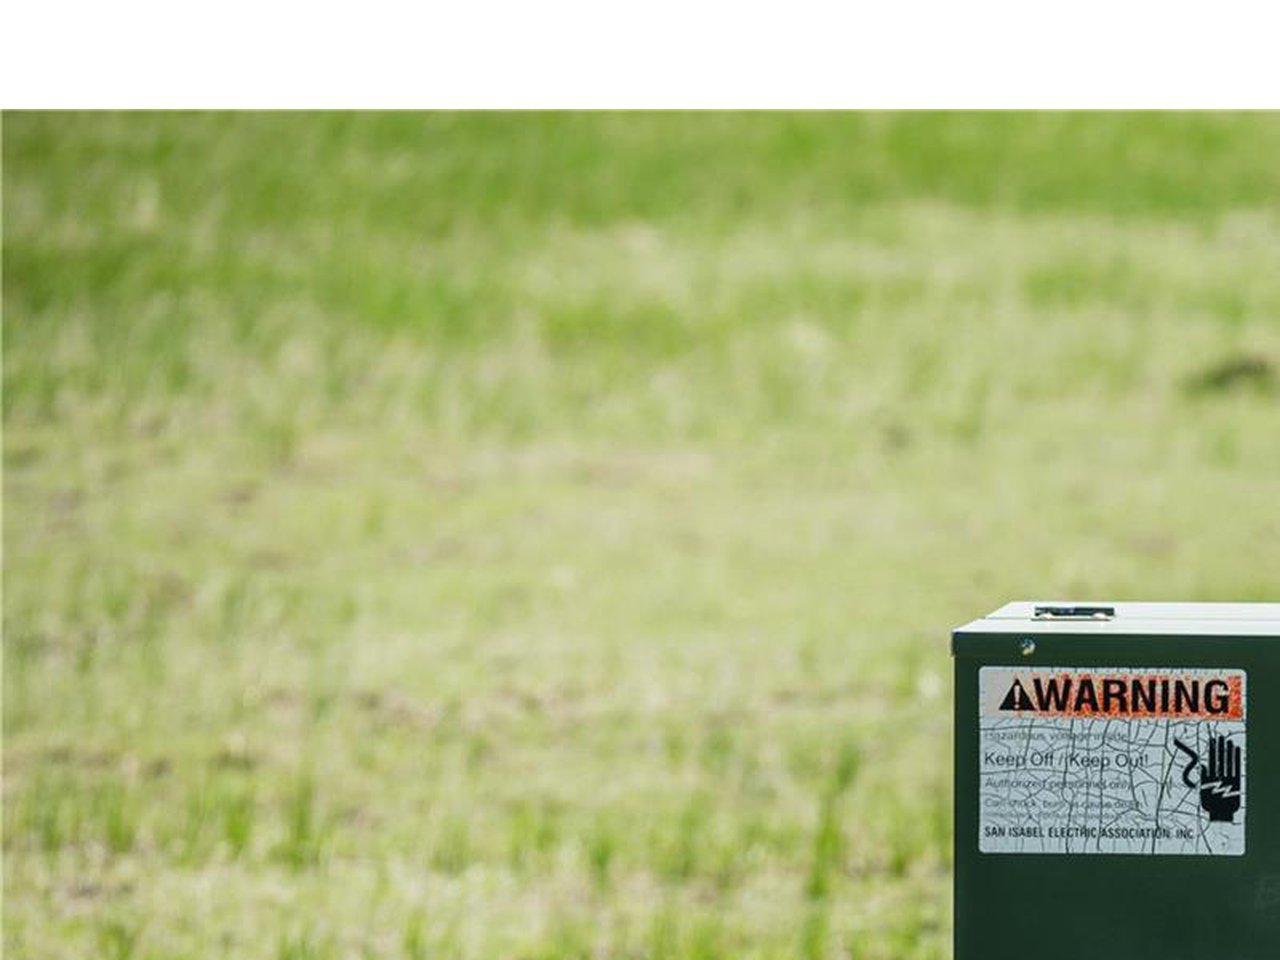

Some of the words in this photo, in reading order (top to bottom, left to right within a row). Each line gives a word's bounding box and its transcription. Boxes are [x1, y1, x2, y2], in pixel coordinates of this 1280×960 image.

[1033, 678, 1229, 714] WARNING
[985, 752, 1026, 770] Keep
[1030, 752, 1054, 767] Off
[1069, 753, 1111, 769] Keep
[1115, 753, 1149, 768] Out!
[985, 826, 1006, 838] SAN
[1009, 826, 1045, 838] ISABEL
[1048, 827, 1097, 838] ELECTRIC
